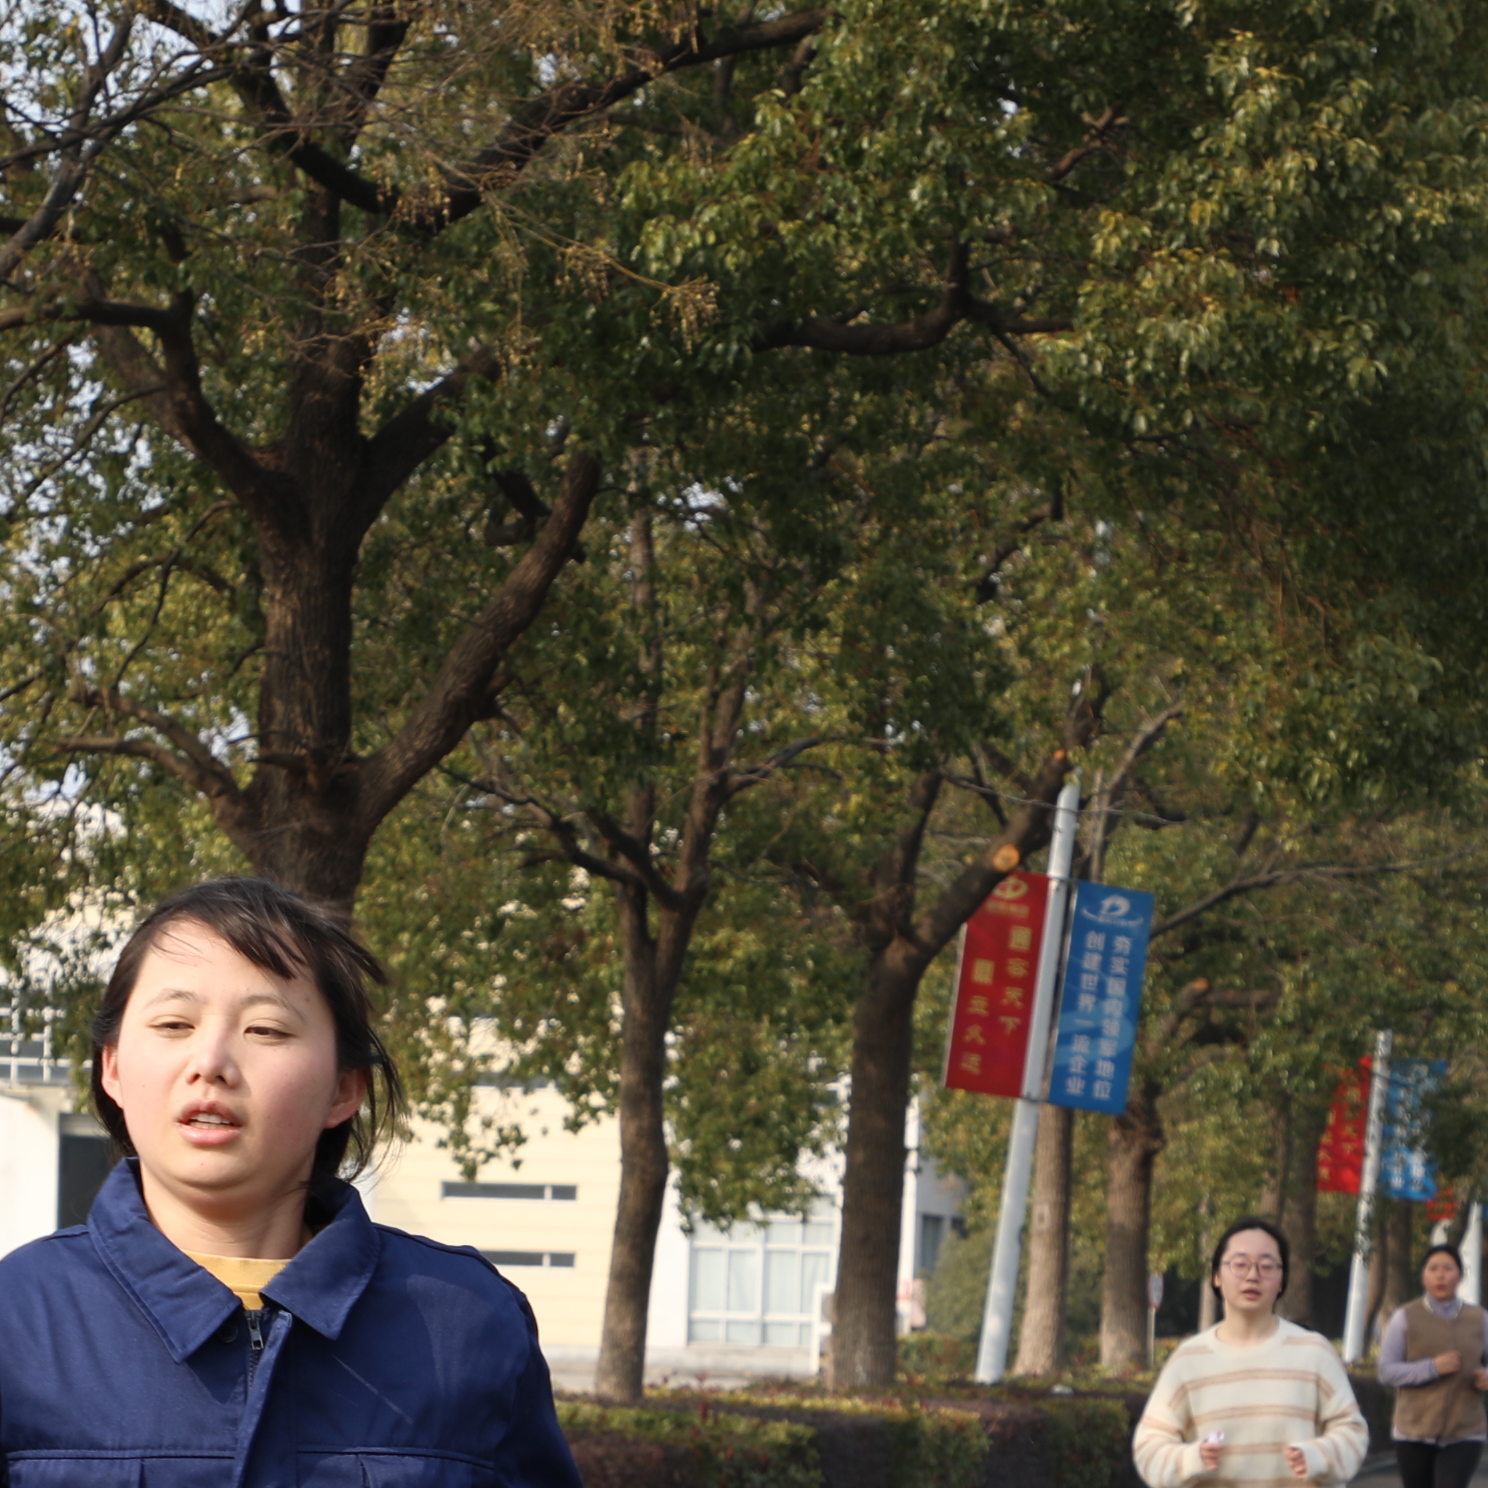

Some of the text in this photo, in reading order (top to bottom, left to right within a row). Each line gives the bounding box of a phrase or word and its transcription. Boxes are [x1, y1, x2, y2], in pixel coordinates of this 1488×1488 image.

[1066, 931, 1107, 1096] 创建世界一流企业
